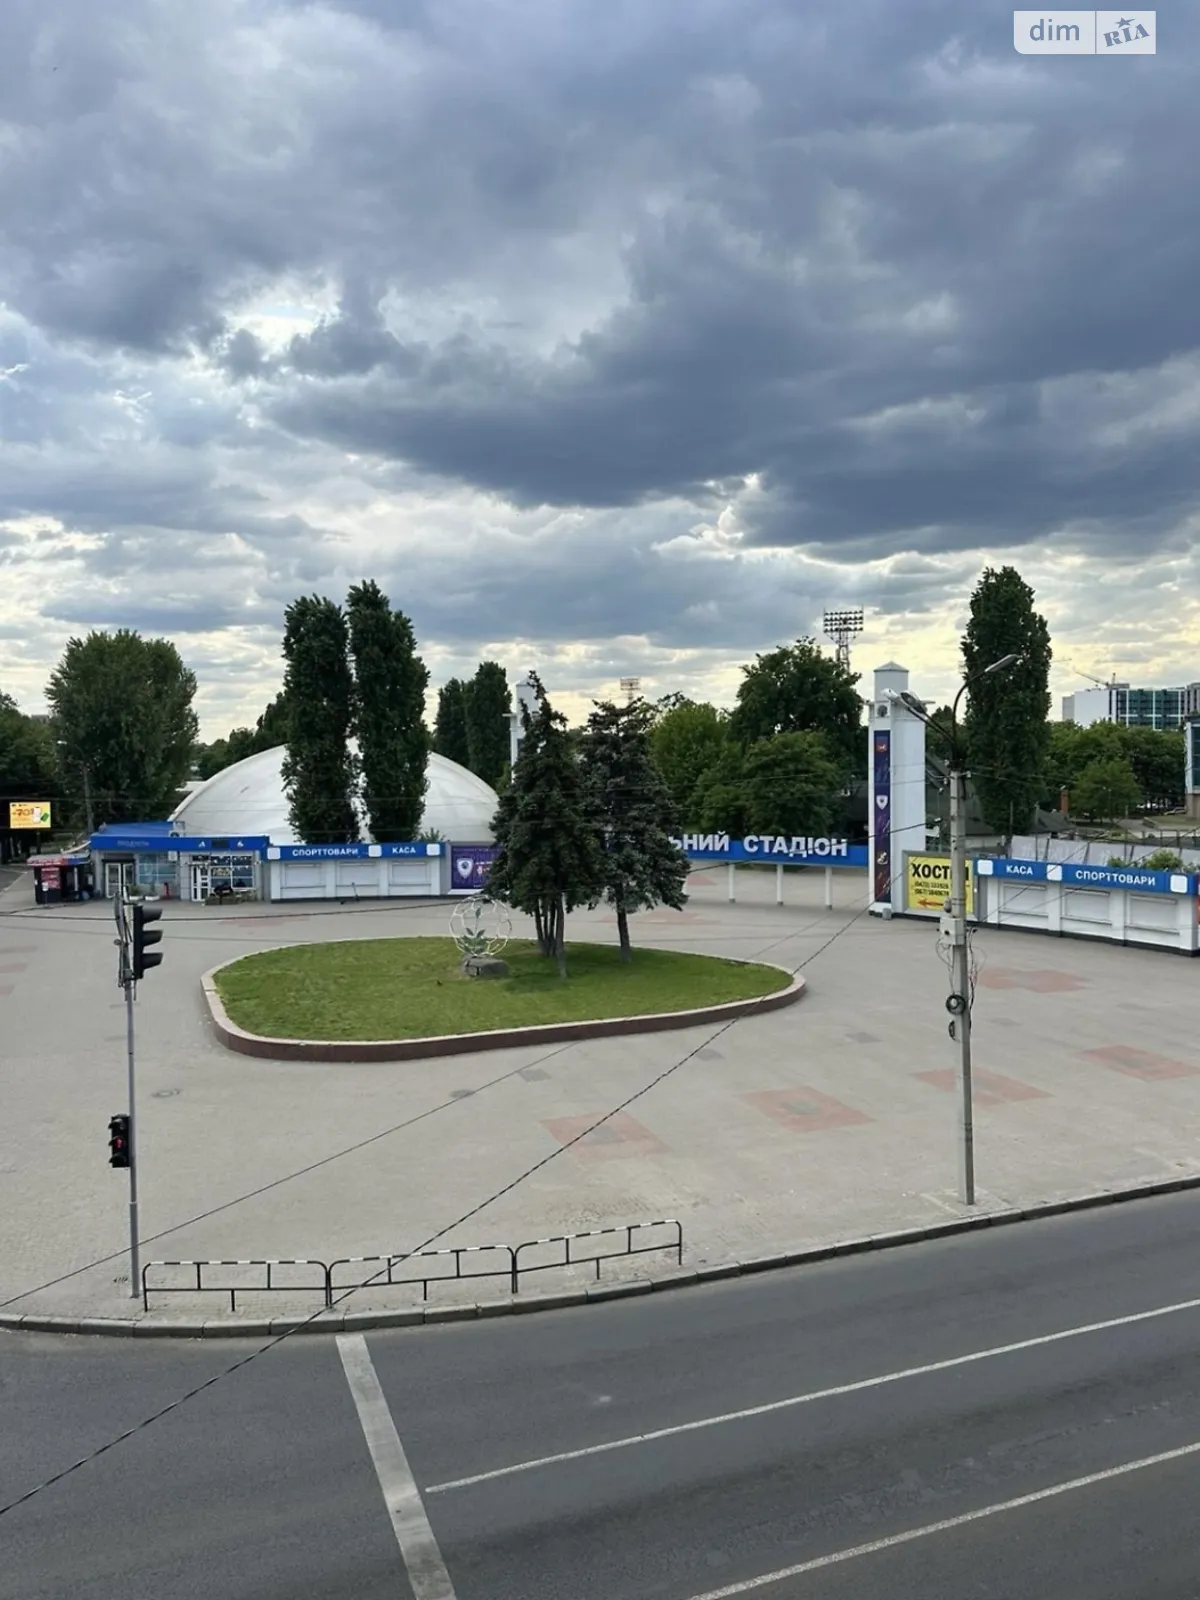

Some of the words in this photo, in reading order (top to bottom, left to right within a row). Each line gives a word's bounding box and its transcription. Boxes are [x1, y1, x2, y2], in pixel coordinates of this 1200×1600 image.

[392, 846, 417, 855] КАСА
[667, 831, 729, 851] ЬНИЙ
[743, 835, 848, 858] СТАДІОН
[292, 847, 359, 857] СПОРТТОВАРИ
[911, 862, 969, 881] ХОСТ
[1005, 864, 1034, 875] КАСА
[1075, 870, 1156, 886] СПОРТТОВАРИ
